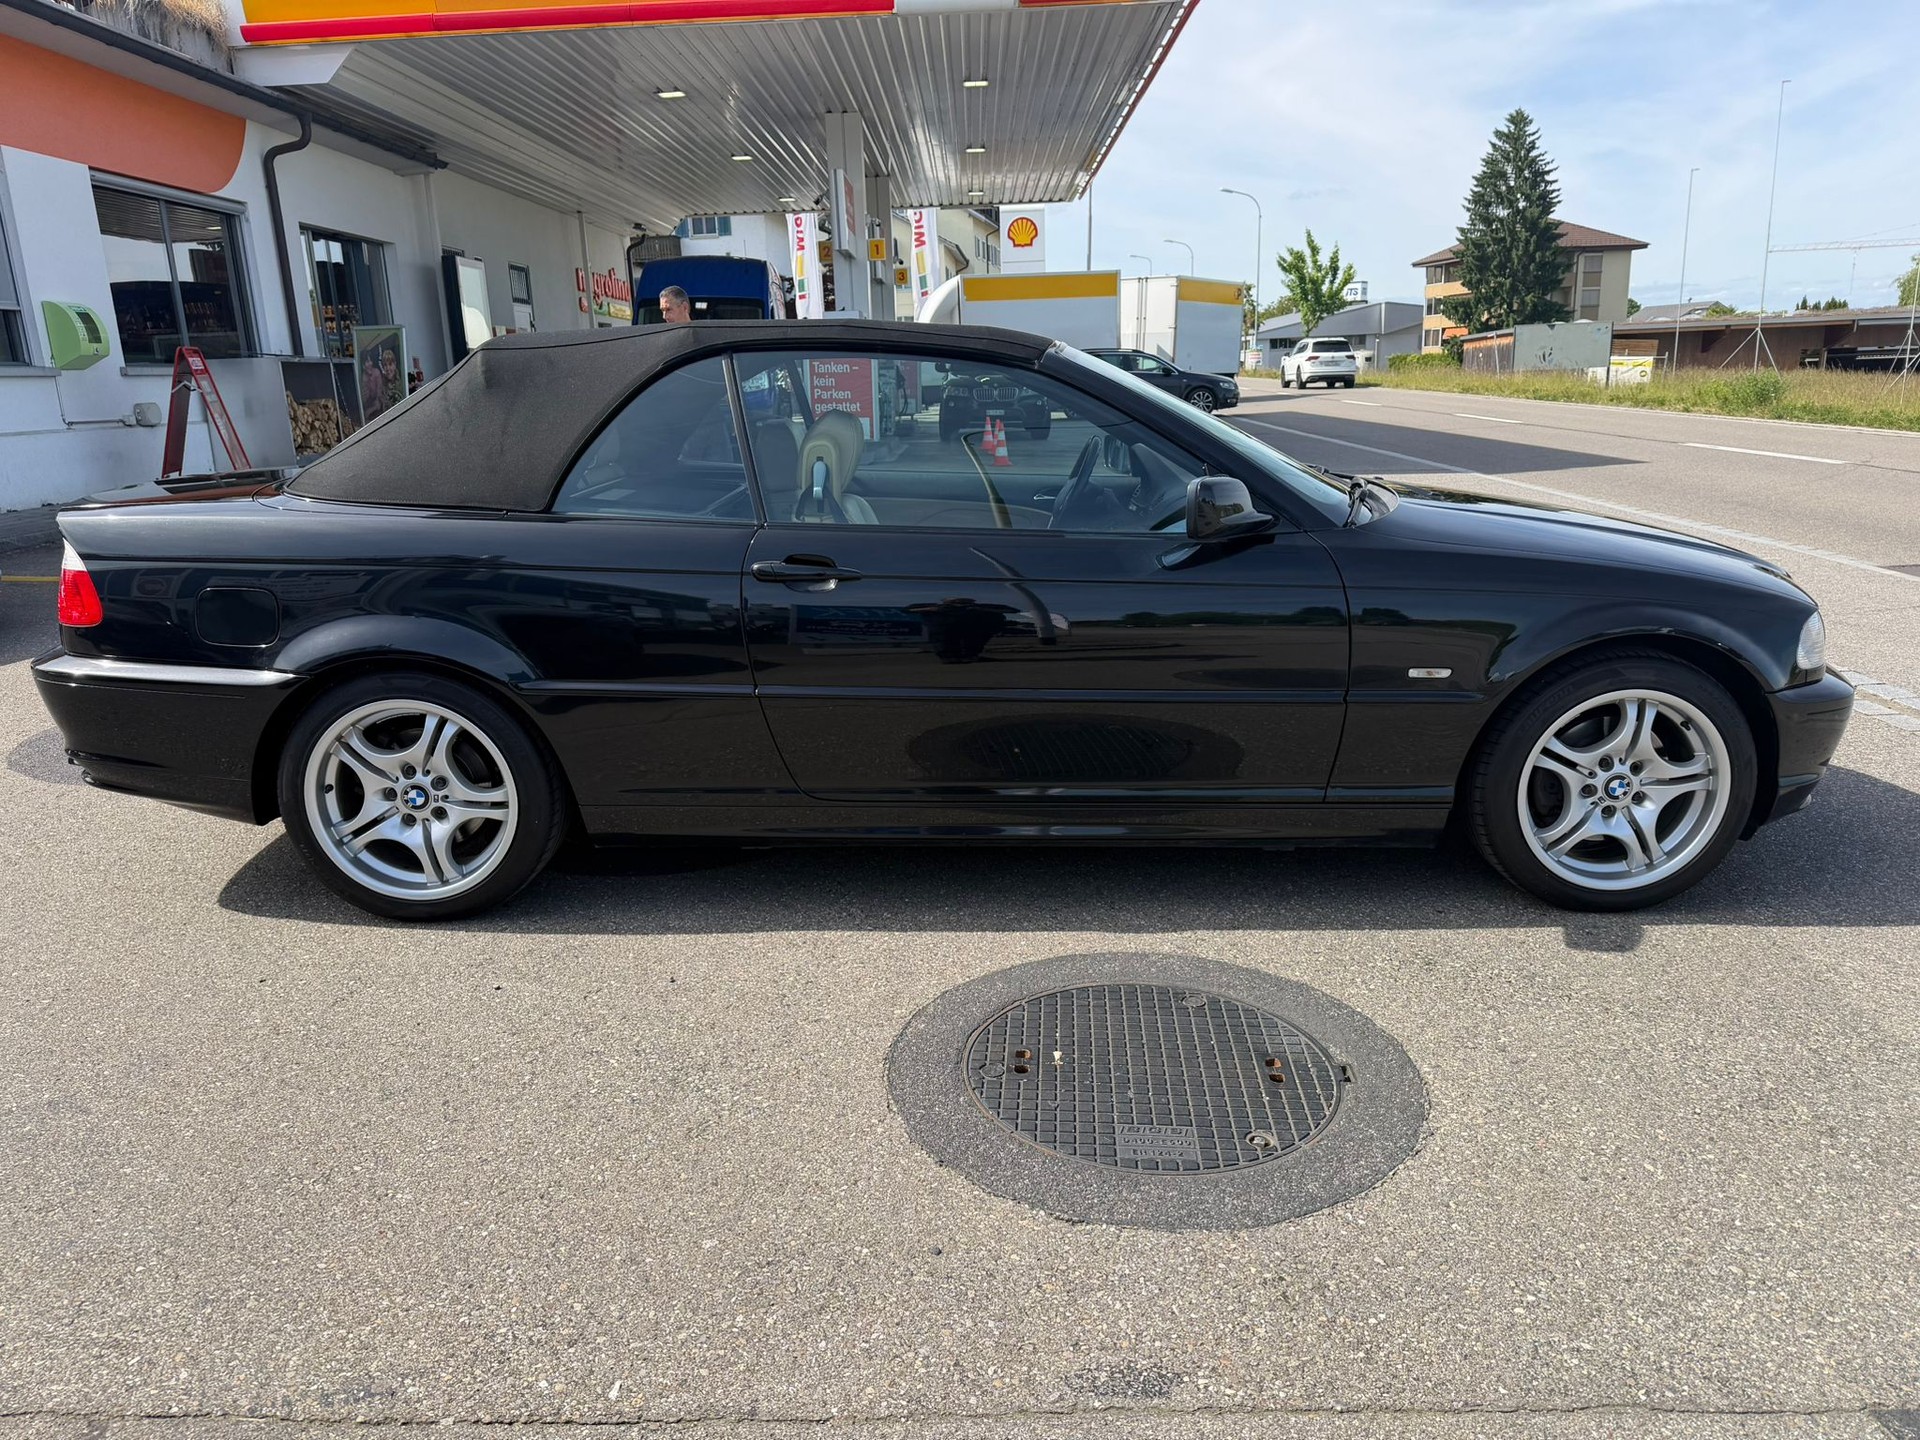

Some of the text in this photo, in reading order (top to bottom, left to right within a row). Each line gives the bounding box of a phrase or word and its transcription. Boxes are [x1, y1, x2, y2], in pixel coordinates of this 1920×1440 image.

[823, 245, 832, 257] 2
[898, 271, 905, 281] 3
[812, 361, 850, 373] Tanken
[813, 375, 835, 387] kein
[814, 388, 852, 399] Parken
[815, 402, 861, 414] gestattet
